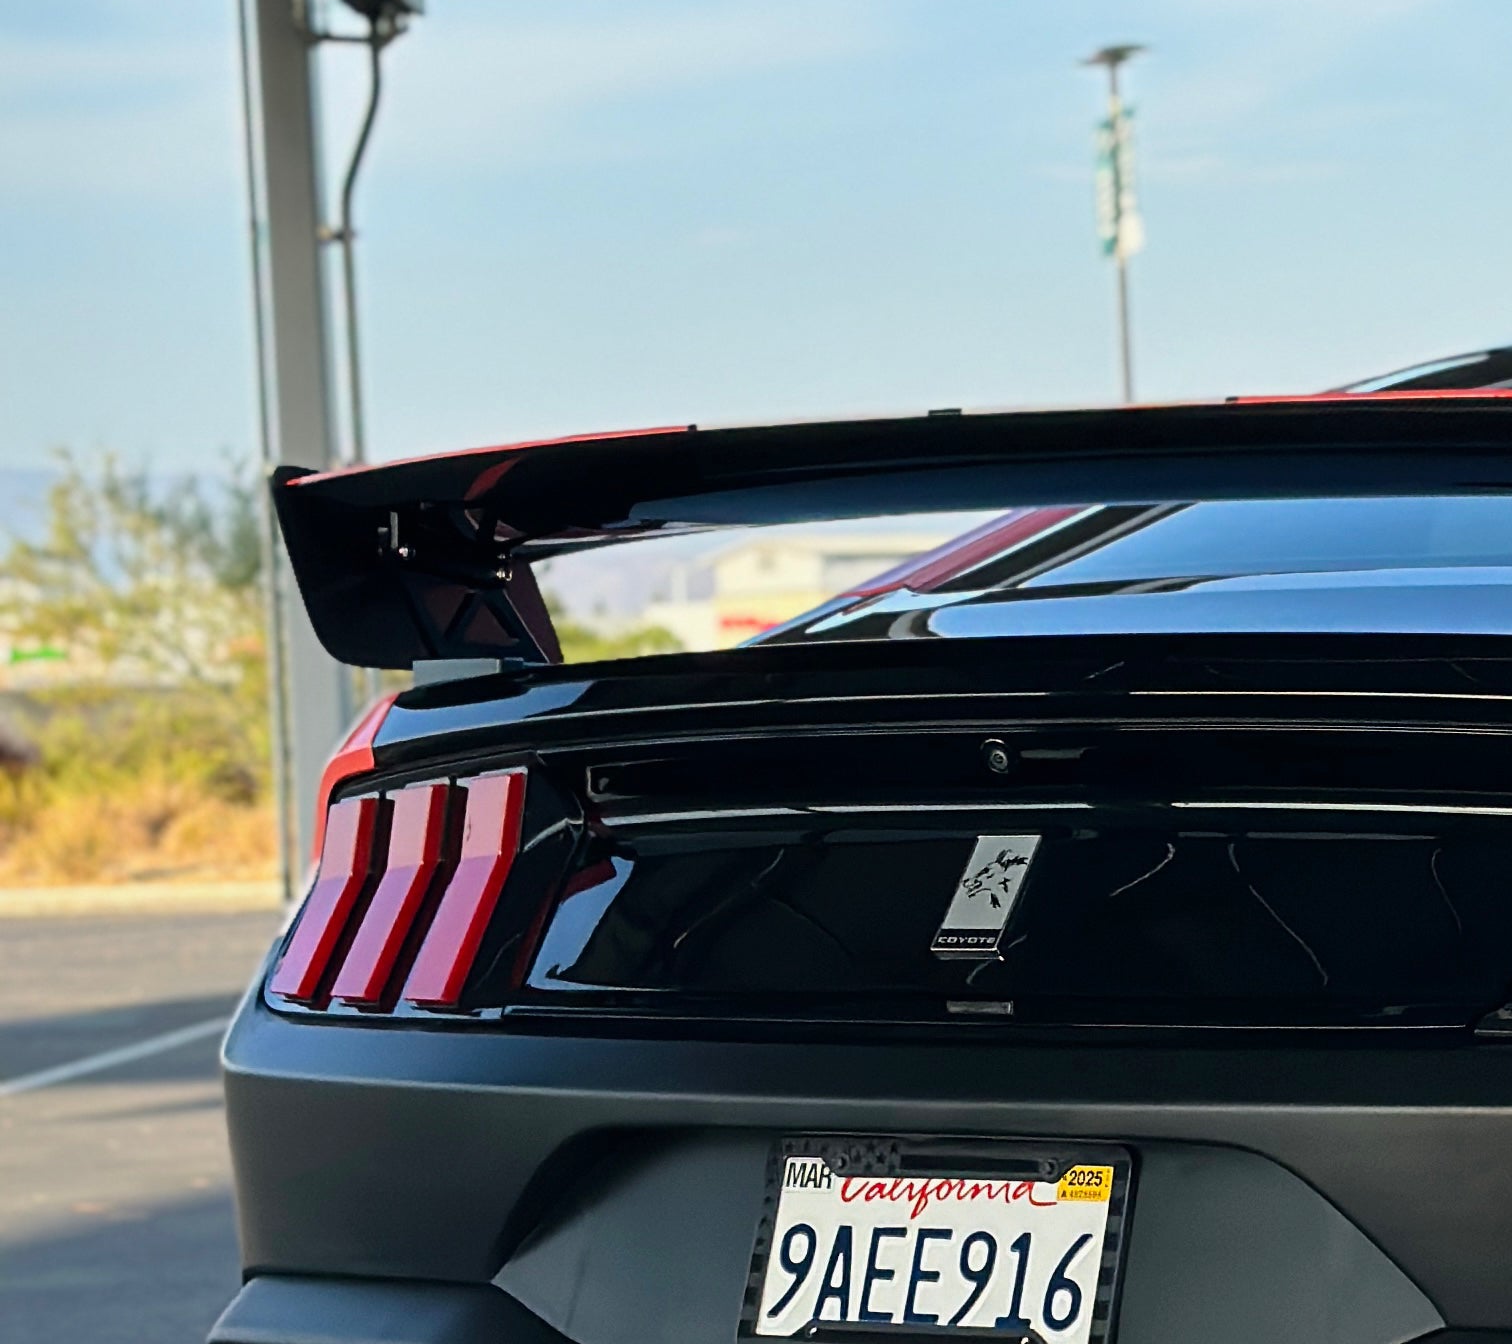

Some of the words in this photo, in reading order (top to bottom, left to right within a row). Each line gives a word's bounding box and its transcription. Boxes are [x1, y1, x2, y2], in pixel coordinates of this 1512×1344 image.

[937, 936, 996, 944] COYOTE
[787, 1162, 833, 1189] MAR
[1068, 1170, 1104, 1187] 2025
[841, 1177, 1057, 1219] California
[767, 1223, 1094, 1332] 9AEE916
